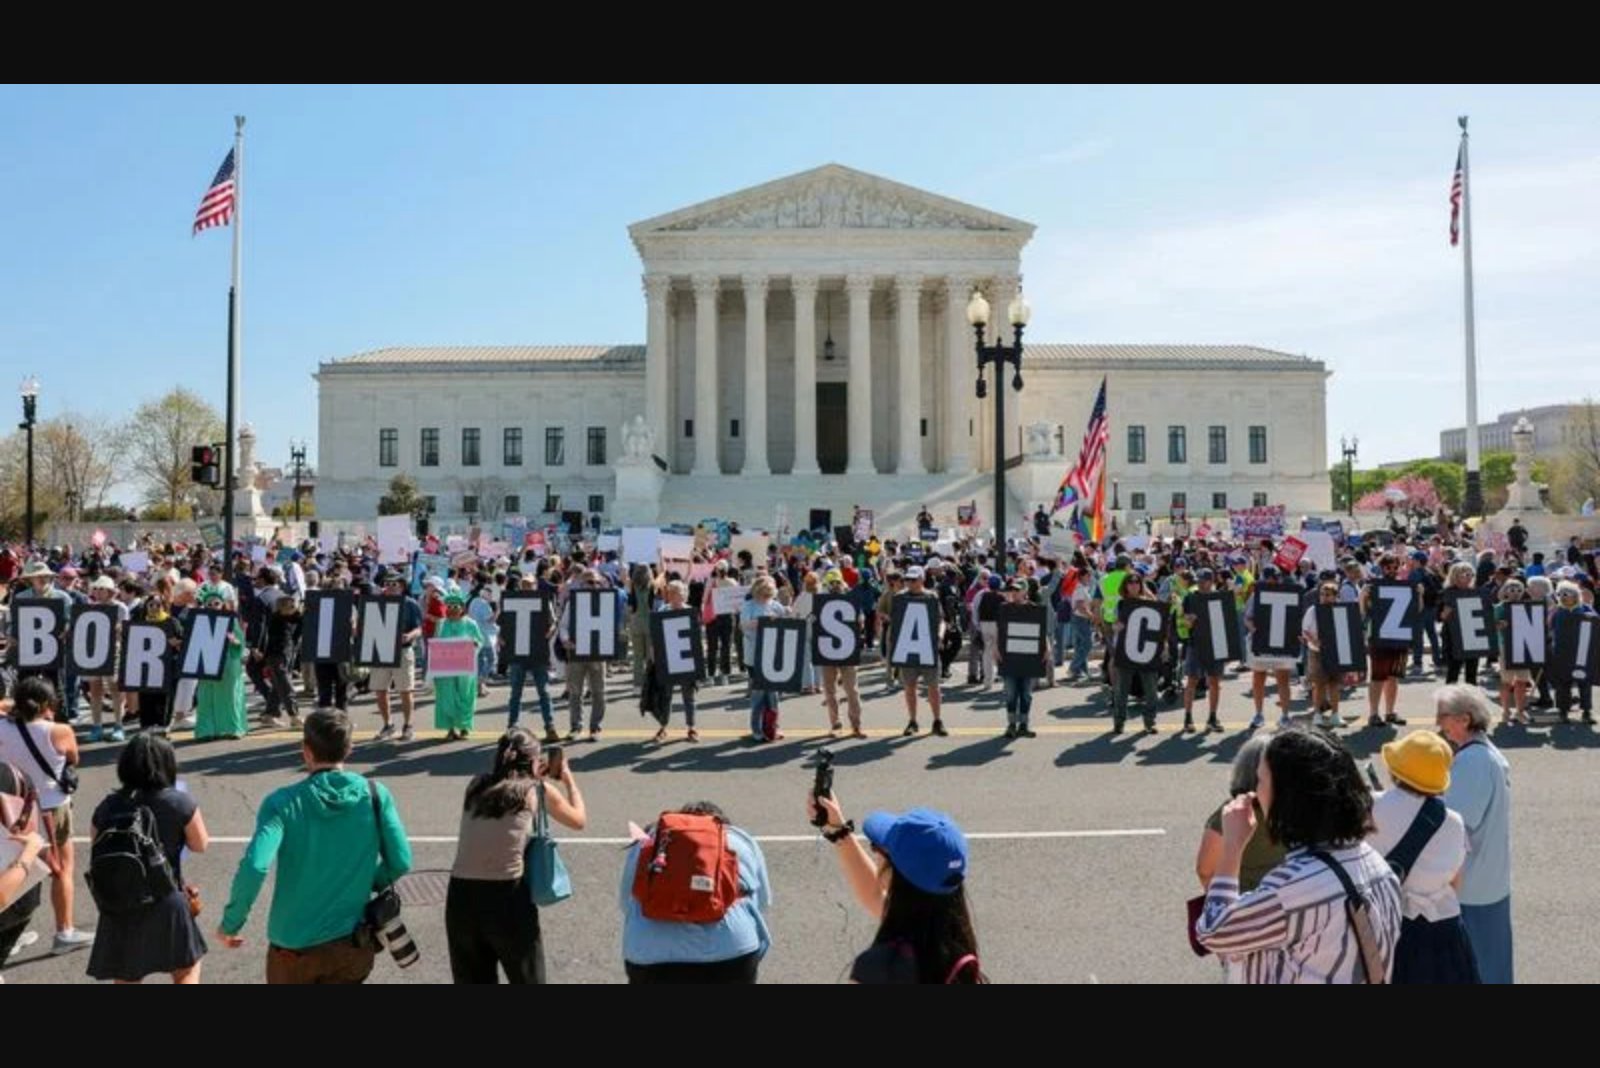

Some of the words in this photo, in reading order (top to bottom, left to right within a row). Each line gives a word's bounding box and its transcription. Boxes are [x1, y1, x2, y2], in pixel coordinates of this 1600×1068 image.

[17, 605, 231, 689] BORN
[316, 596, 401, 665] IN
[502, 590, 696, 675] THE
[761, 599, 935, 684] USA
